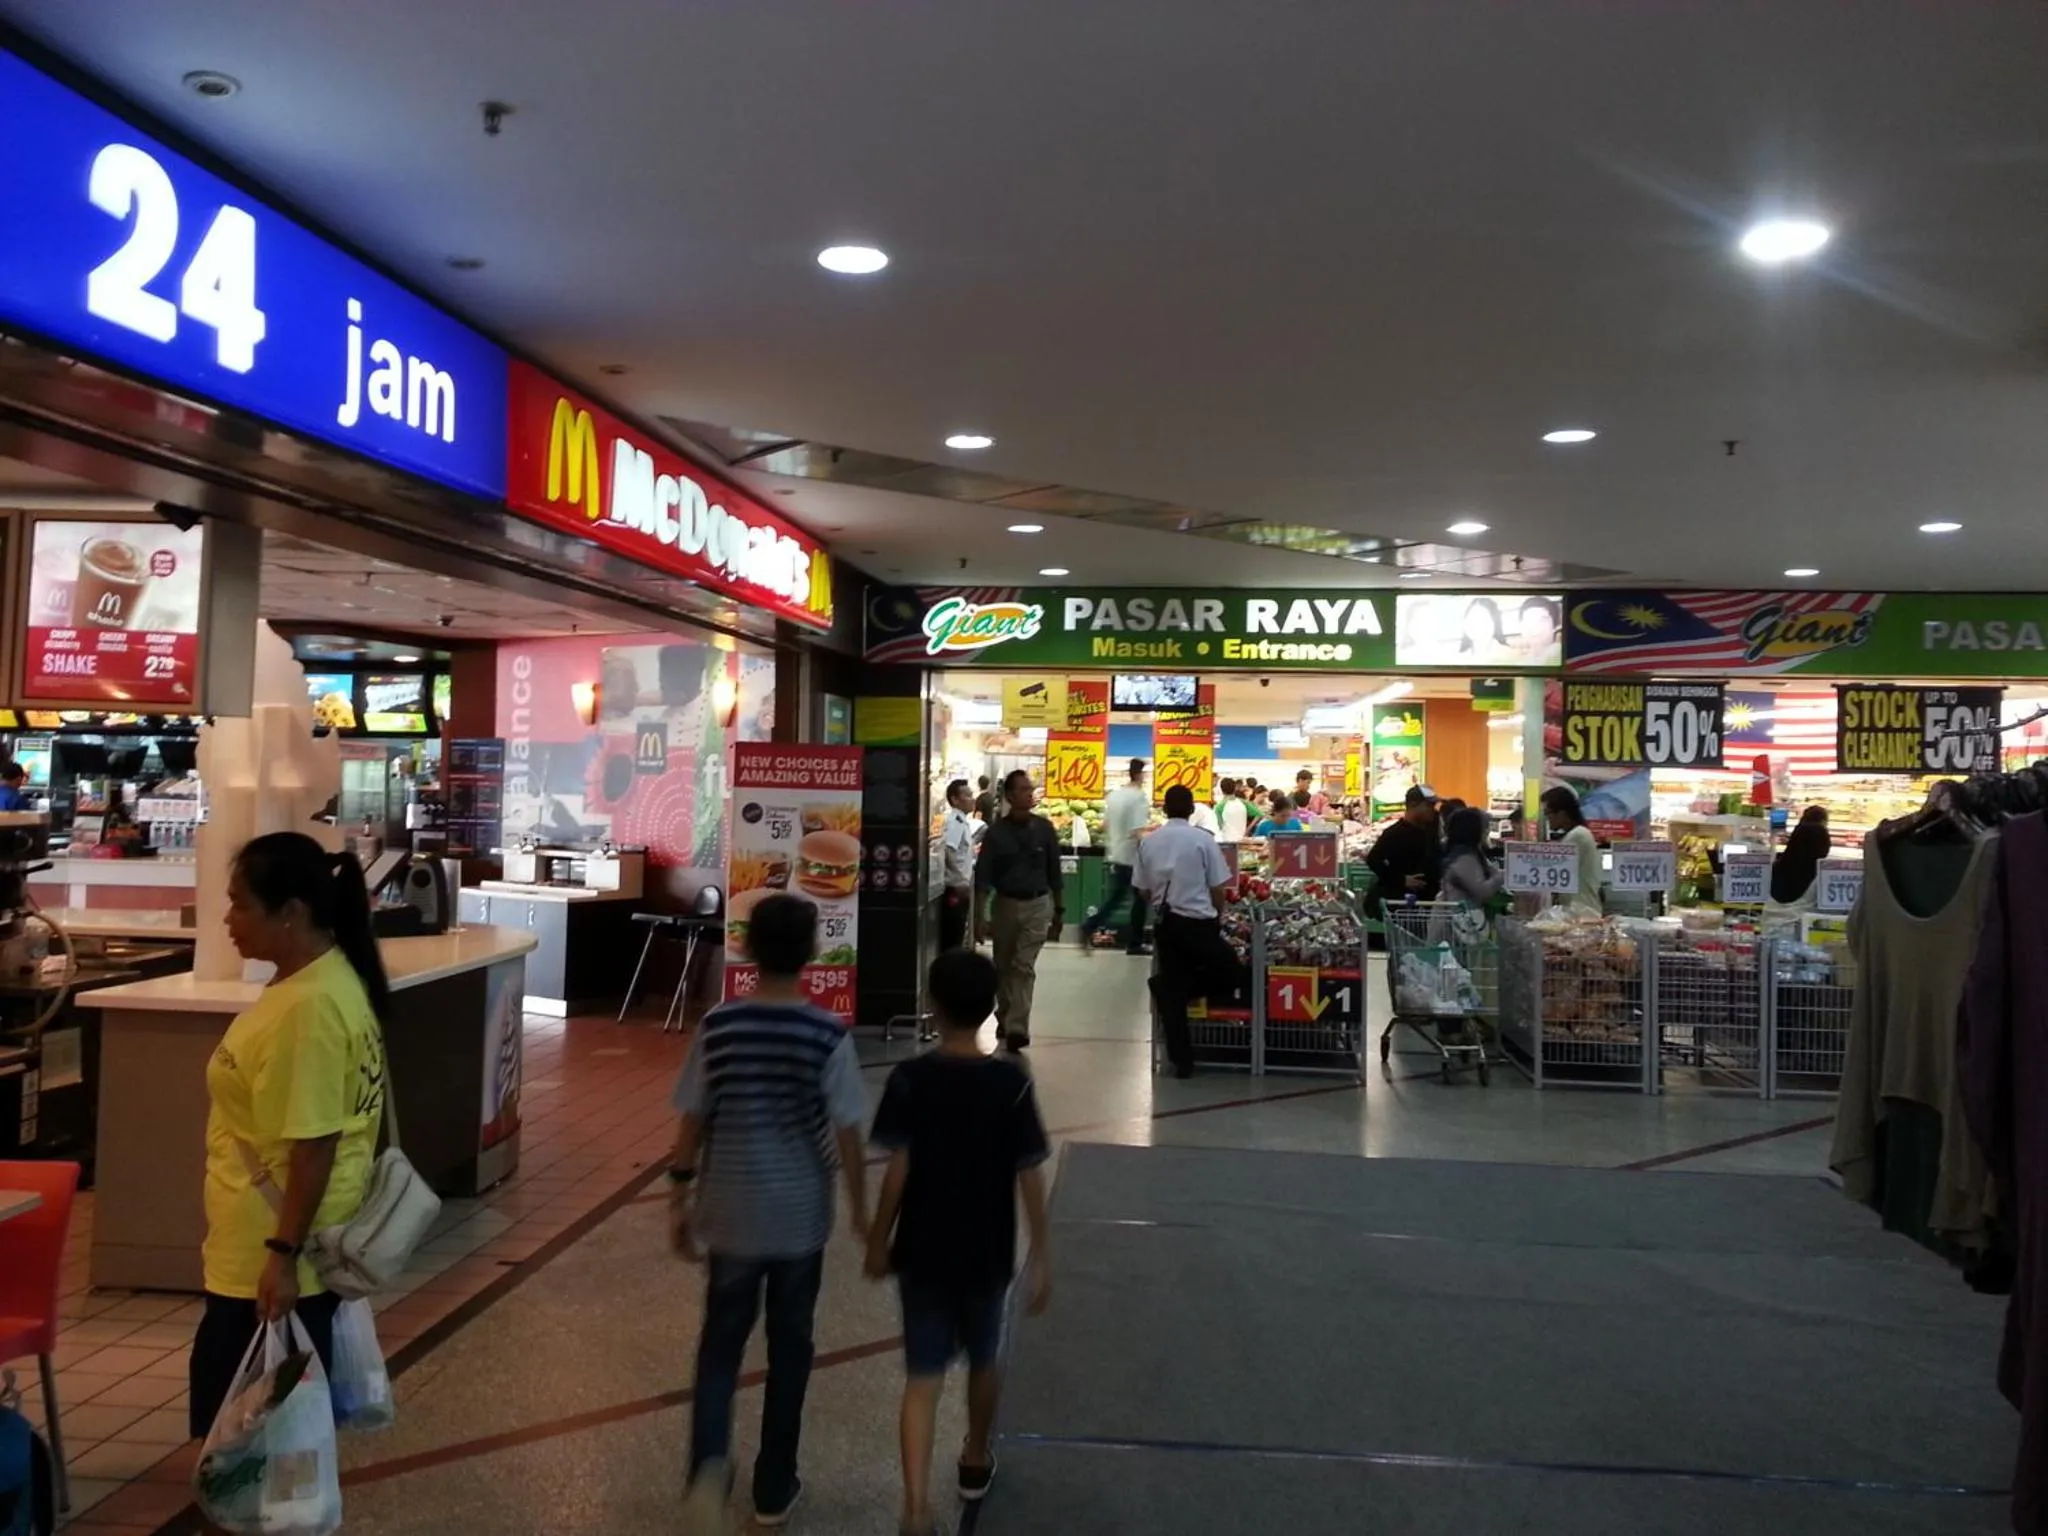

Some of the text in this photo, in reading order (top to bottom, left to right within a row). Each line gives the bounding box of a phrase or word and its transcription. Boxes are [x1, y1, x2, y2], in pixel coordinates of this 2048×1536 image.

[87, 143, 455, 442] 24 jam
[923, 597, 1383, 653] Giant PASAR RAYA
[1740, 604, 2048, 662] Giant PASA
[1092, 637, 1353, 661] Masuk Entrance
[42, 653, 99, 675] SHAKE
[1567, 684, 1643, 712] PENGHABISAN
[1845, 690, 1958, 729] STOCK UP TO
[1566, 715, 1643, 762] STOK
[1645, 700, 1719, 764] 50%
[1924, 706, 1995, 770] 50%
[740, 755, 859, 771] NEW CHOICES AT
[1844, 731, 1922, 769] CLEARANCE
[740, 769, 857, 785] AMAZING VALUE
[1294, 843, 1308, 870] 1
[1529, 867, 1571, 887] 3.99
[1730, 882, 1762, 897] STOCKS
[1828, 883, 1864, 902] STO
[1278, 983, 1294, 1011] 1
[1335, 986, 1351, 1013] 1
